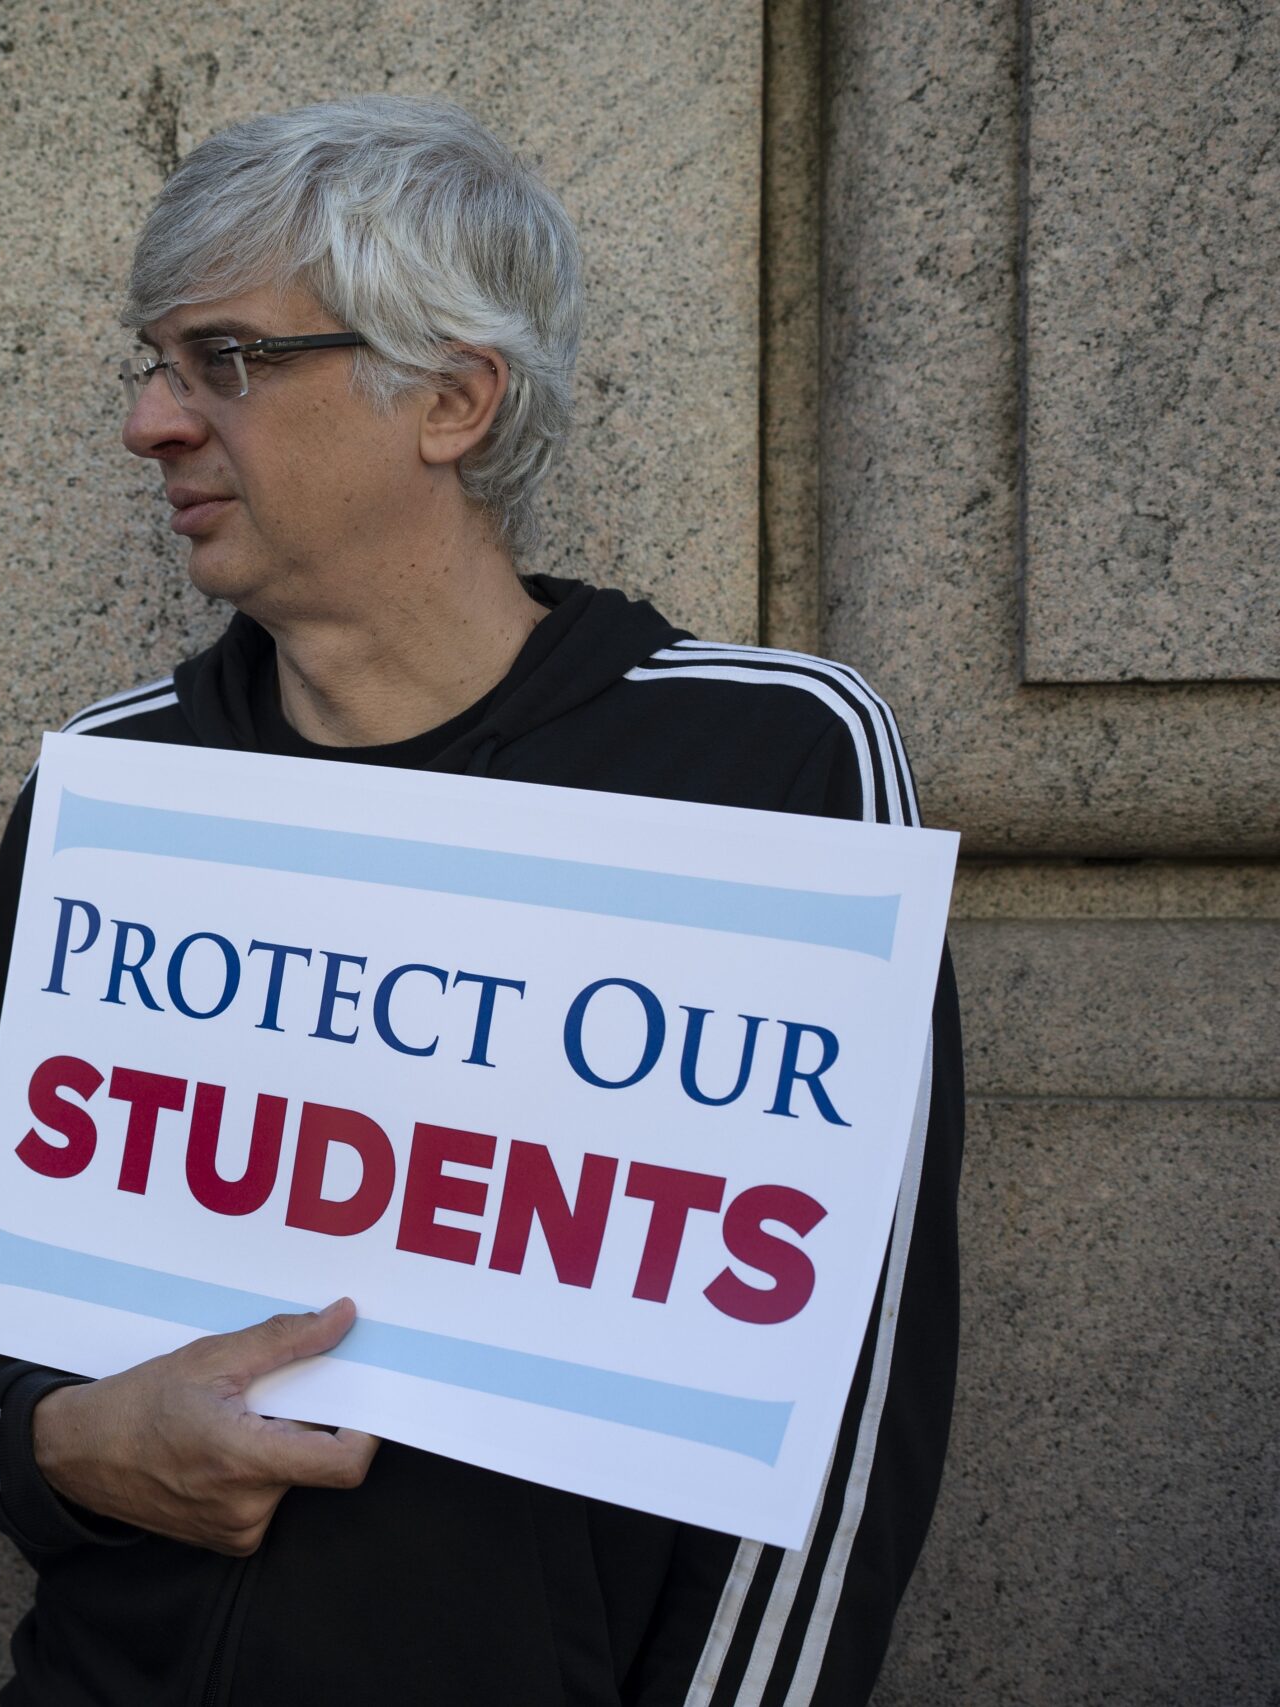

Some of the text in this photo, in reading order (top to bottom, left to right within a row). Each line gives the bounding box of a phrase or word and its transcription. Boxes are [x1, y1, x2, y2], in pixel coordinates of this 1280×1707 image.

[41, 897, 852, 1128] PROTECT OUR
[15, 1055, 829, 1325] STUDENTS
